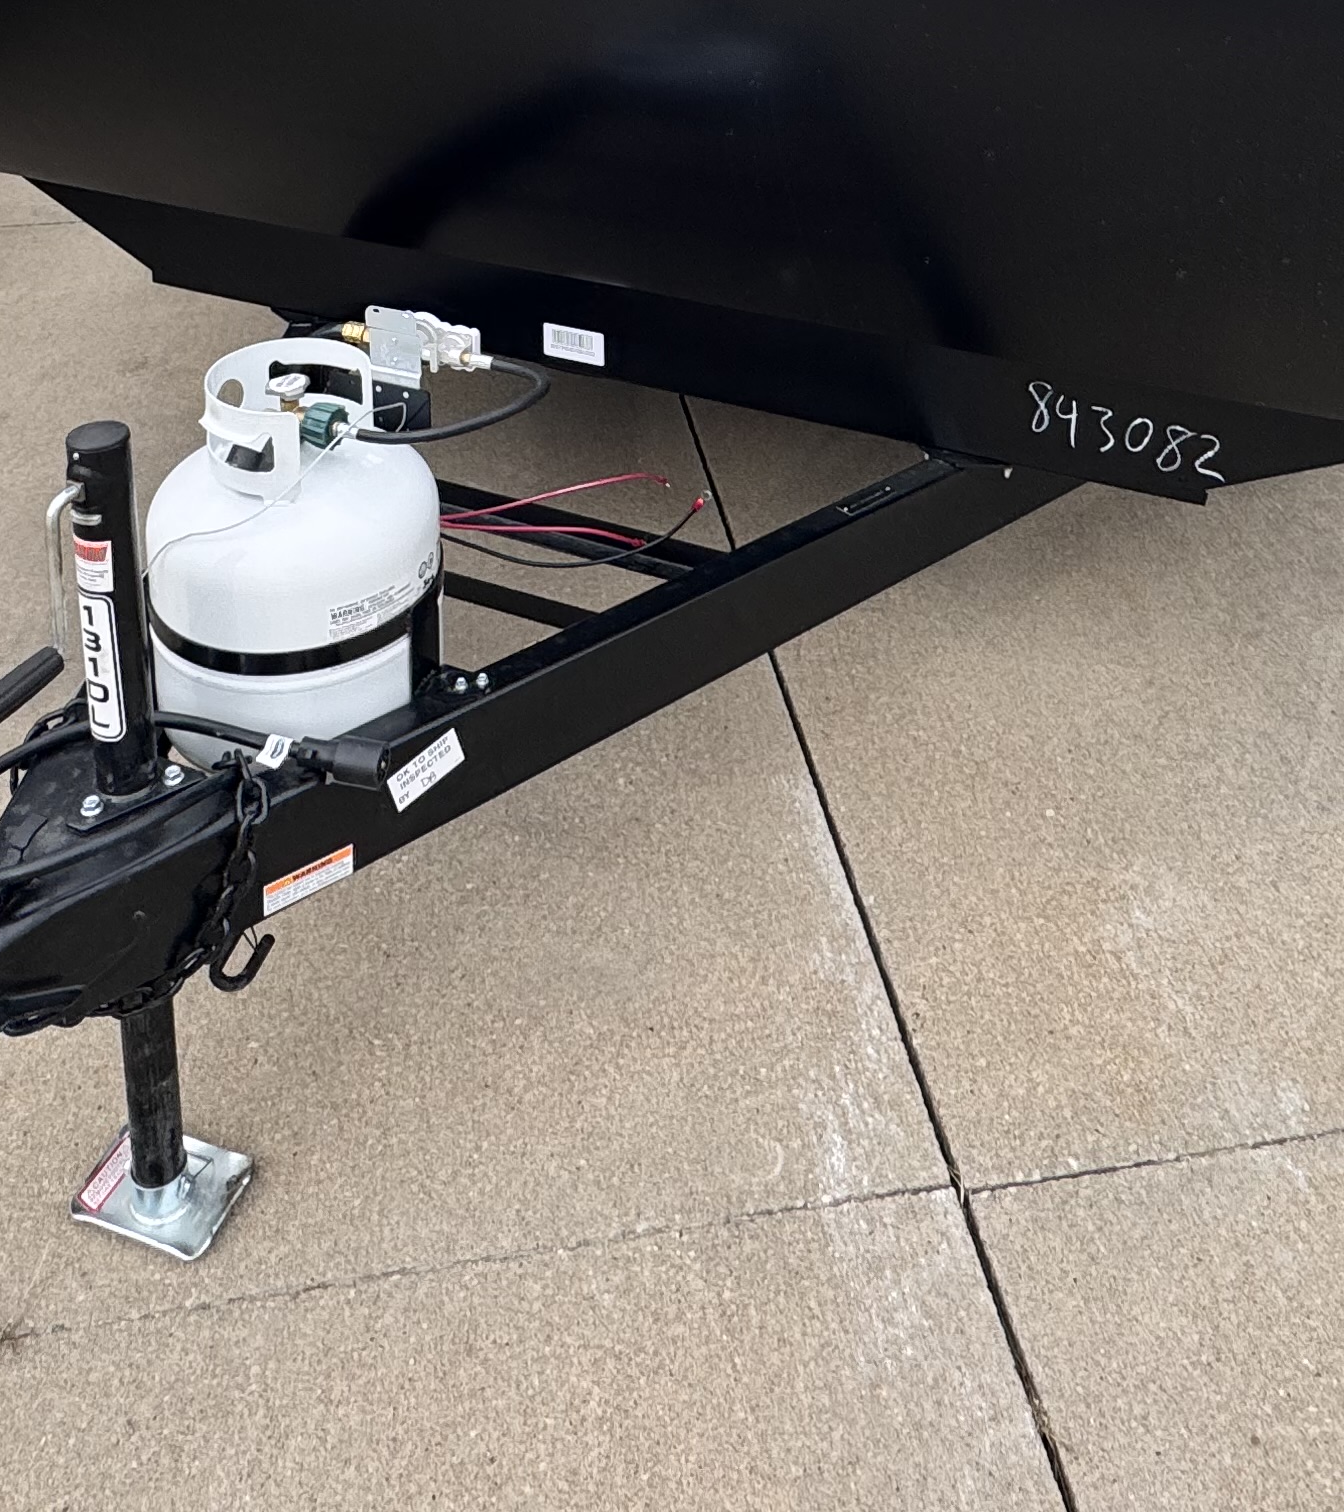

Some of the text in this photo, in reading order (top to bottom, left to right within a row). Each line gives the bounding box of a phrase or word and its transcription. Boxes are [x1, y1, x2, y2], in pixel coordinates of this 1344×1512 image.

[1028, 381, 1226, 482] 843082
[396, 736, 449, 782] OK TO SHIP
[399, 744, 451, 790] INSPECTED
[398, 791, 410, 804] BY
[93, 1151, 123, 1190] CAUTION
